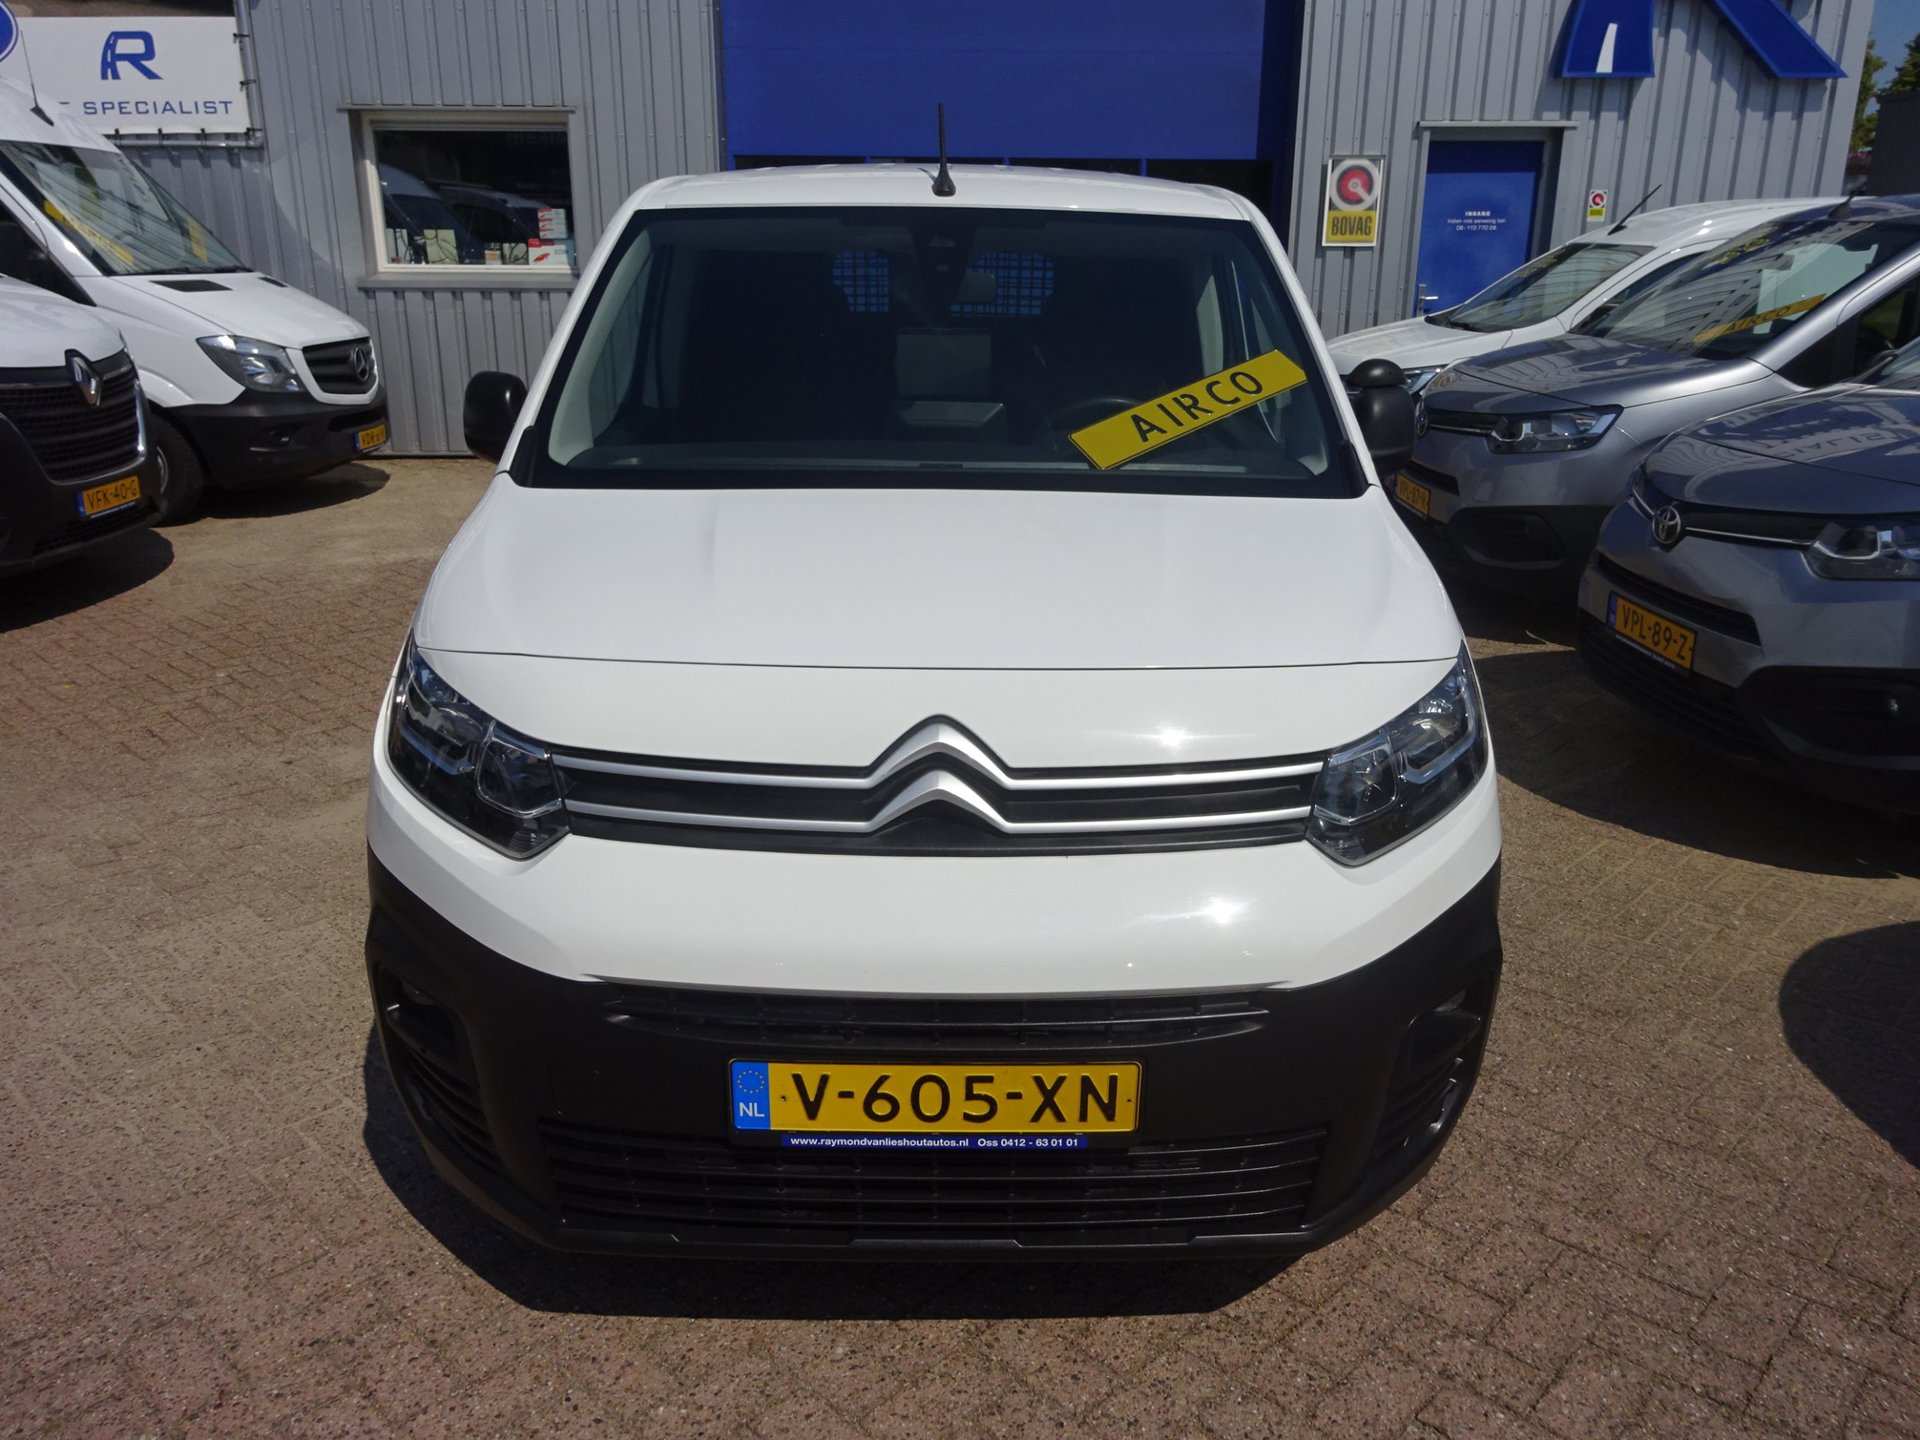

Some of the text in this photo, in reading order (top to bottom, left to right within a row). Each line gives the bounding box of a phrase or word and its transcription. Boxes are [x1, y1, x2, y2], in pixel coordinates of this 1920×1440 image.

[83, 101, 233, 115] SPECIALIST
[1331, 216, 1373, 236] BOVAG
[1130, 371, 1263, 442] AIRCO
[1622, 604, 1688, 661] VPL-89-Z
[791, 1073, 1118, 1123] V-605-XN
[739, 1102, 765, 1117] NL
[790, 1137, 969, 1148] www.raymondvanlieshoutautos.nl
[977, 1139, 998, 1147] Oss
[1000, 1139, 1026, 1147] 0412
[1035, 1139, 1049, 1147] 63
[1051, 1139, 1063, 1147] 01
[1066, 1139, 1078, 1147] 01
